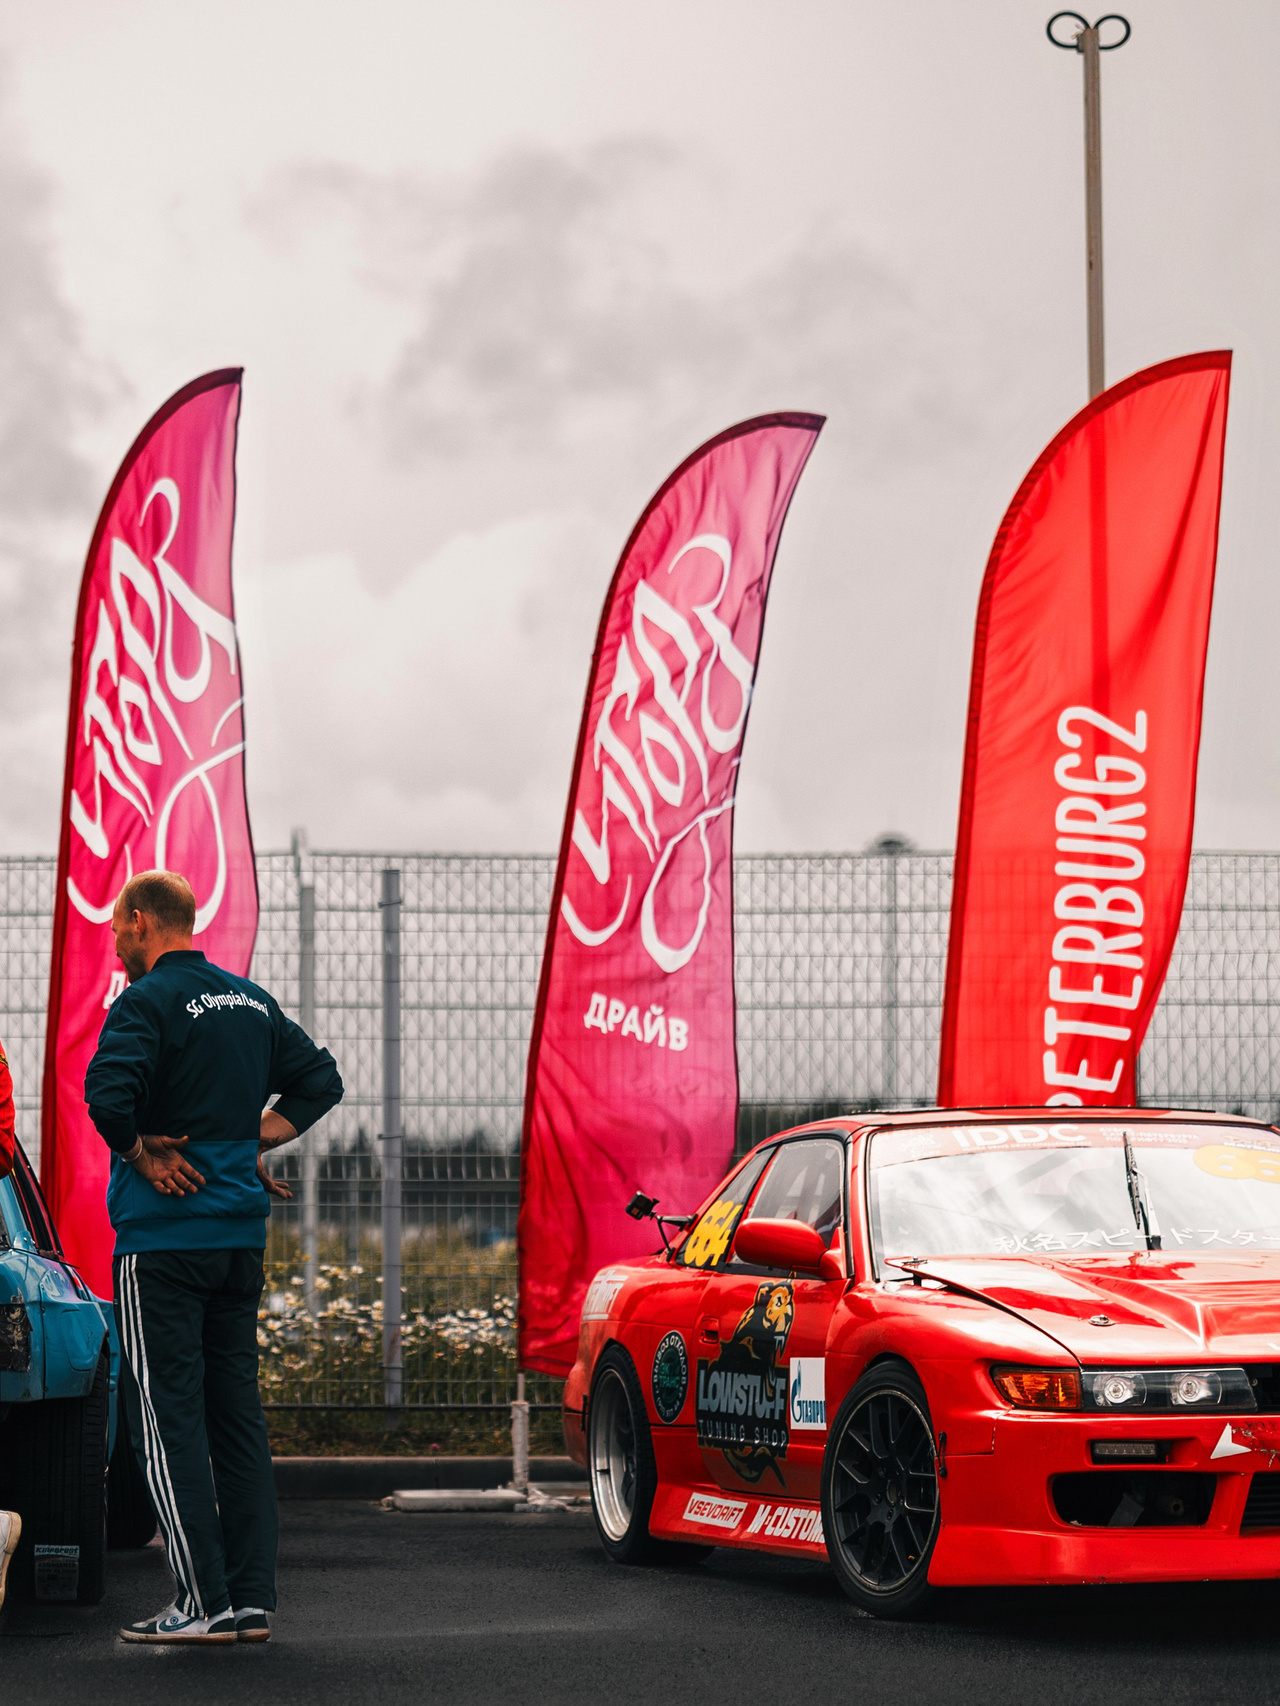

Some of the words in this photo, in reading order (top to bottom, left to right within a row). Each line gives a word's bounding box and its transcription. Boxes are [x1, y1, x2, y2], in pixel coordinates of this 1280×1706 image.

[1043, 705, 1148, 1106] ETERBURG2
[185, 998, 205, 1019] SG
[583, 991, 689, 1052] ДРАЙВ
[951, 1124, 1086, 1148] IDDC
[684, 1199, 744, 1267] 664
[698, 1419, 746, 1442] TUNING
[754, 1426, 787, 1447] SHOP
[687, 1498, 744, 1524] VSEVDRIFT
[746, 1503, 826, 1544] M-CUSTOM
